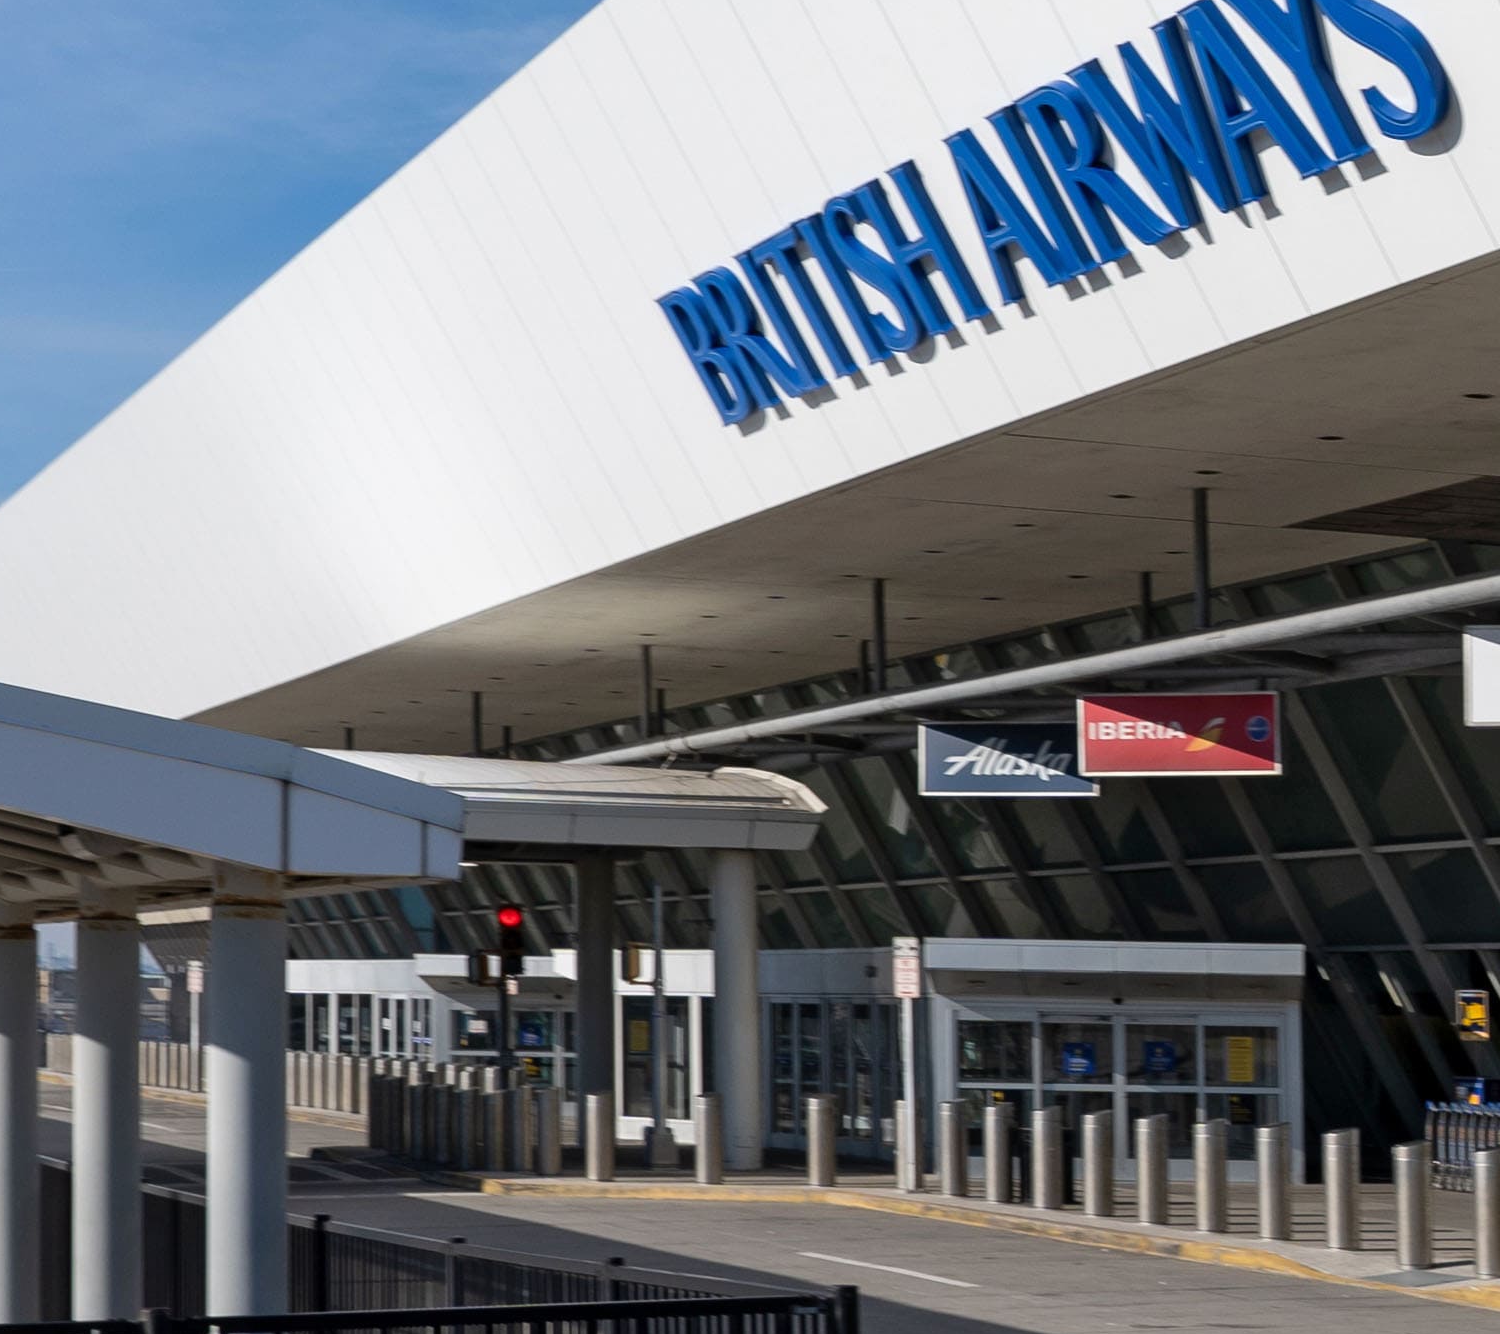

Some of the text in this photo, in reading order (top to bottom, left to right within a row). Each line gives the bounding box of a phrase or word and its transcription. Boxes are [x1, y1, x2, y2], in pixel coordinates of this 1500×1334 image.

[656, 159, 991, 427] BRITISH
[1088, 720, 1187, 741] IBERIA
[943, 737, 1072, 782] Alaska
